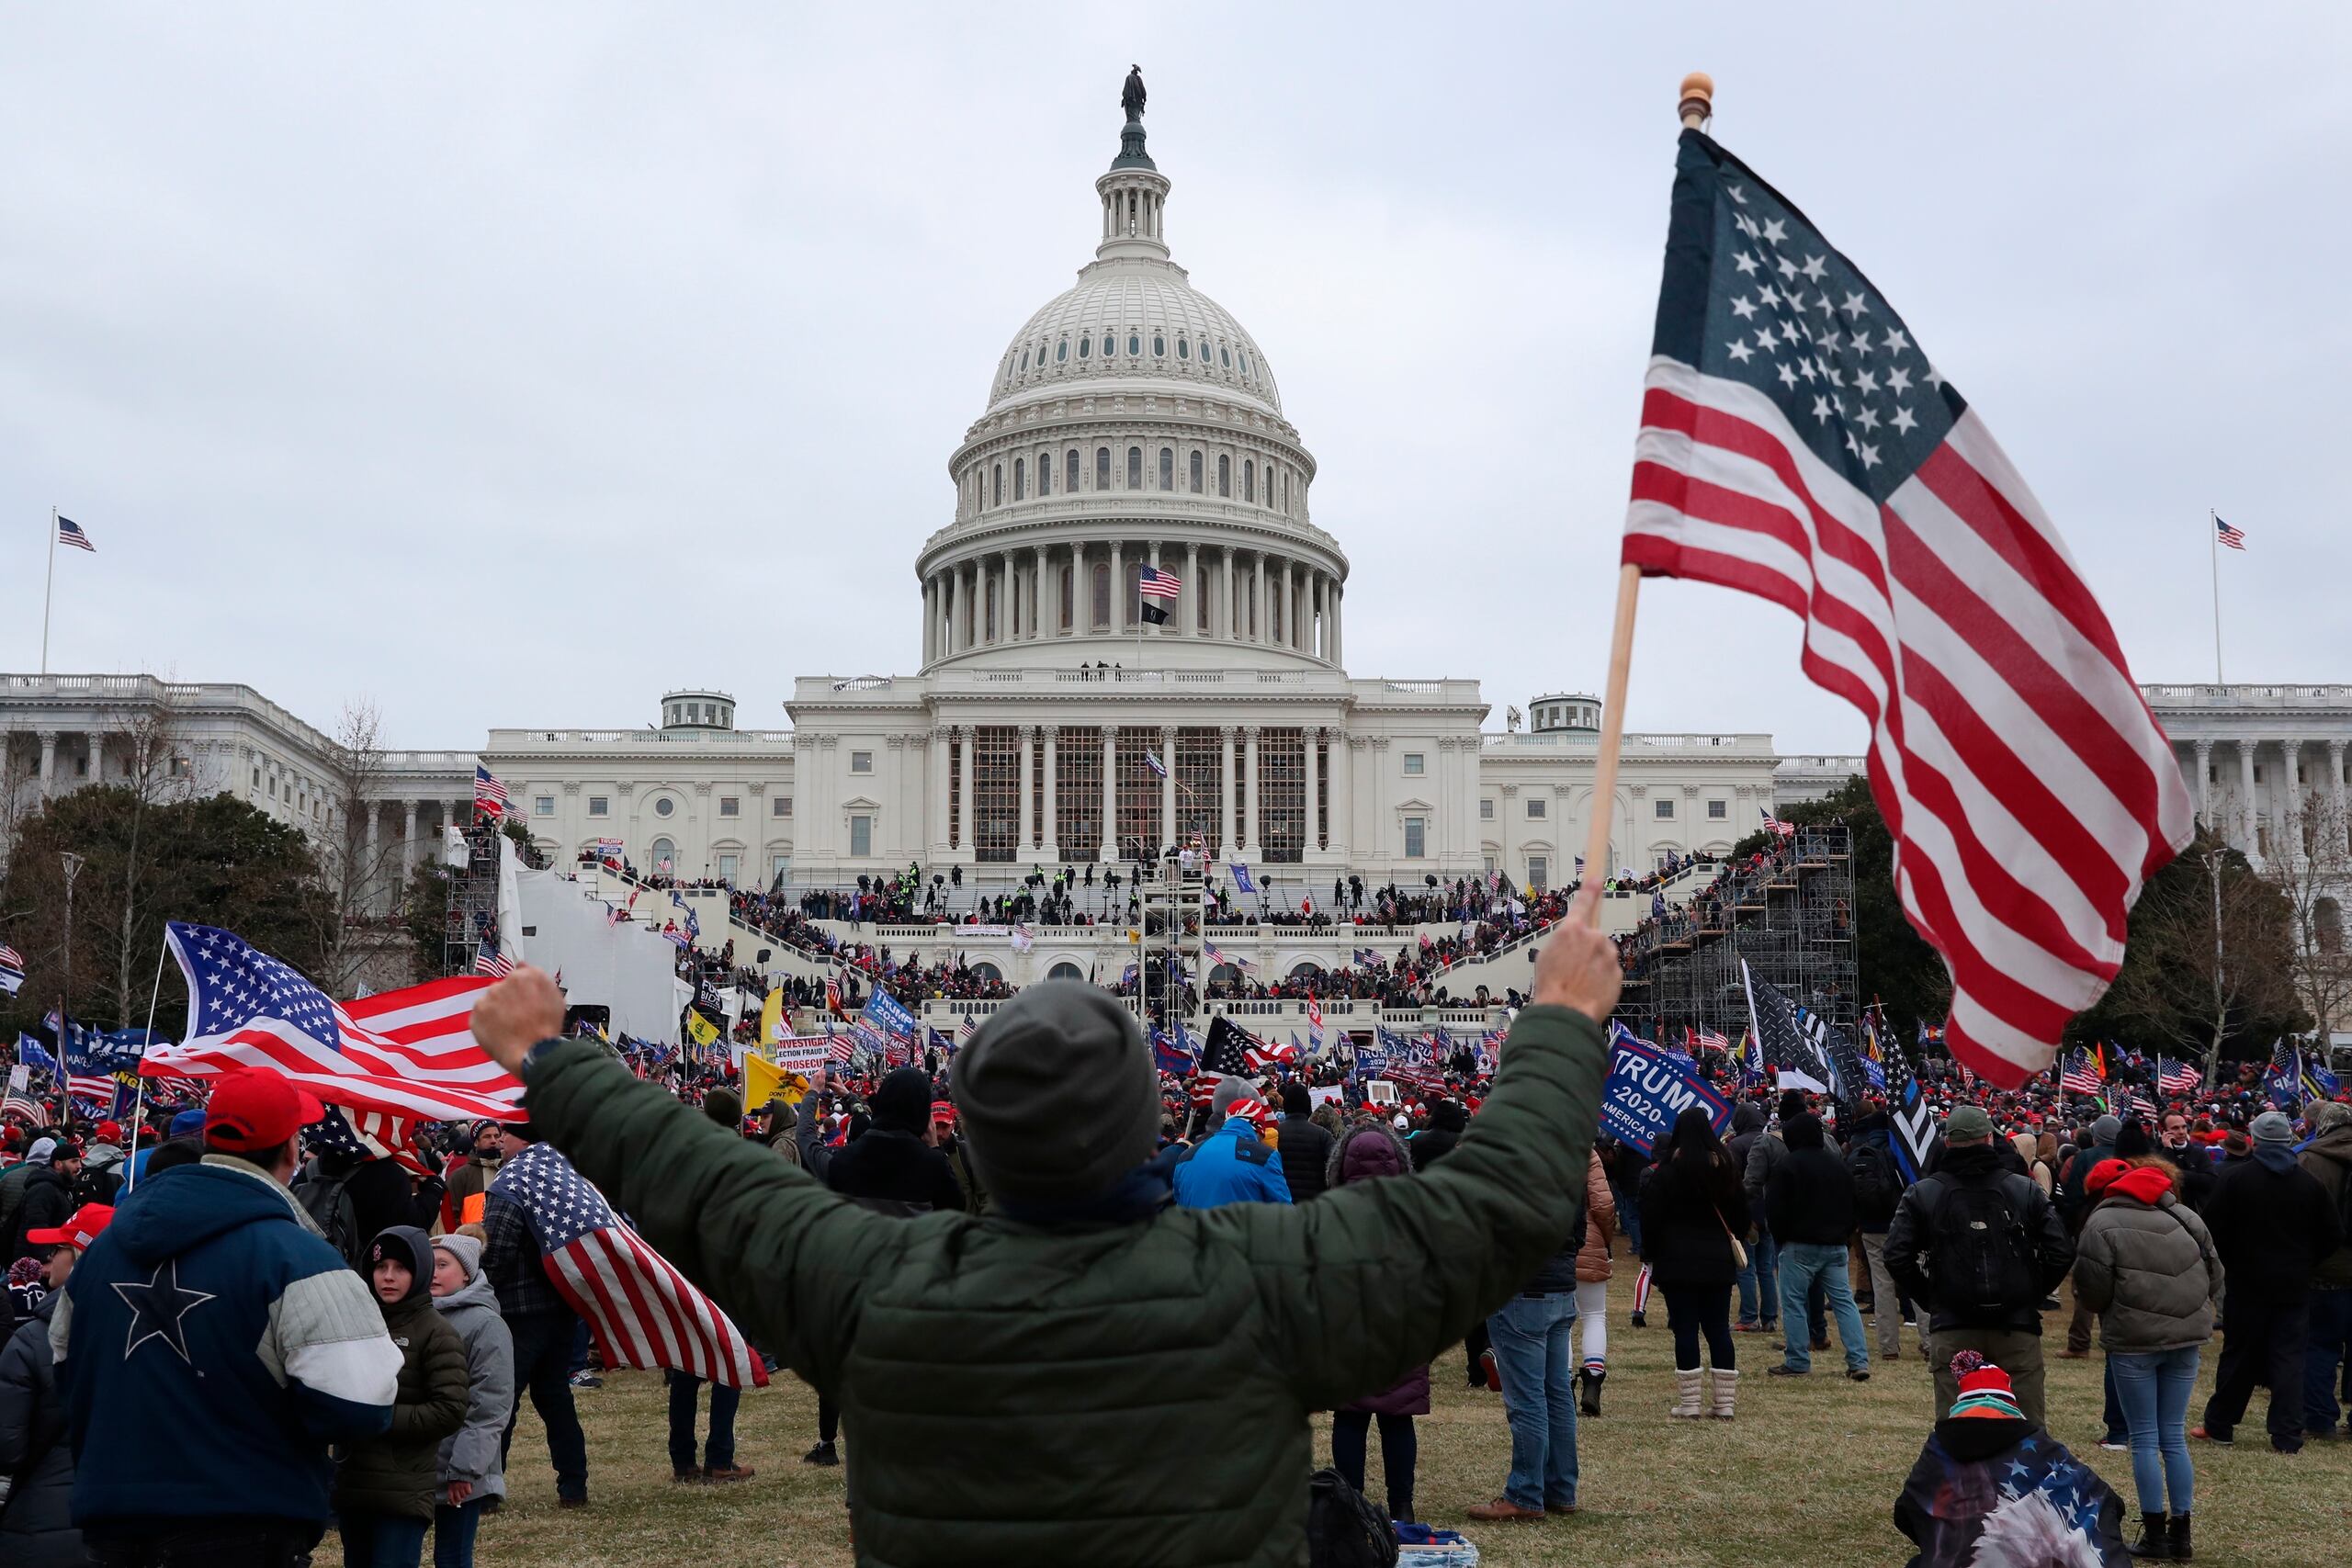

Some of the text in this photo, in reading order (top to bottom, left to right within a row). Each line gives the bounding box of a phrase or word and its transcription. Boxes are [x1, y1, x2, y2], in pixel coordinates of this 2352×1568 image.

[599, 837, 624, 845] TRUMP
[877, 988, 913, 1024] TRUMP
[876, 1005, 904, 1032] 2024
[777, 1037, 830, 1049] INVESTIGAT
[776, 1050, 801, 1058] LECTION
[802, 1048, 822, 1056] FRAUD
[780, 1058, 826, 1070] PROSECUT
[1600, 1101, 1645, 1136] AMERICA
